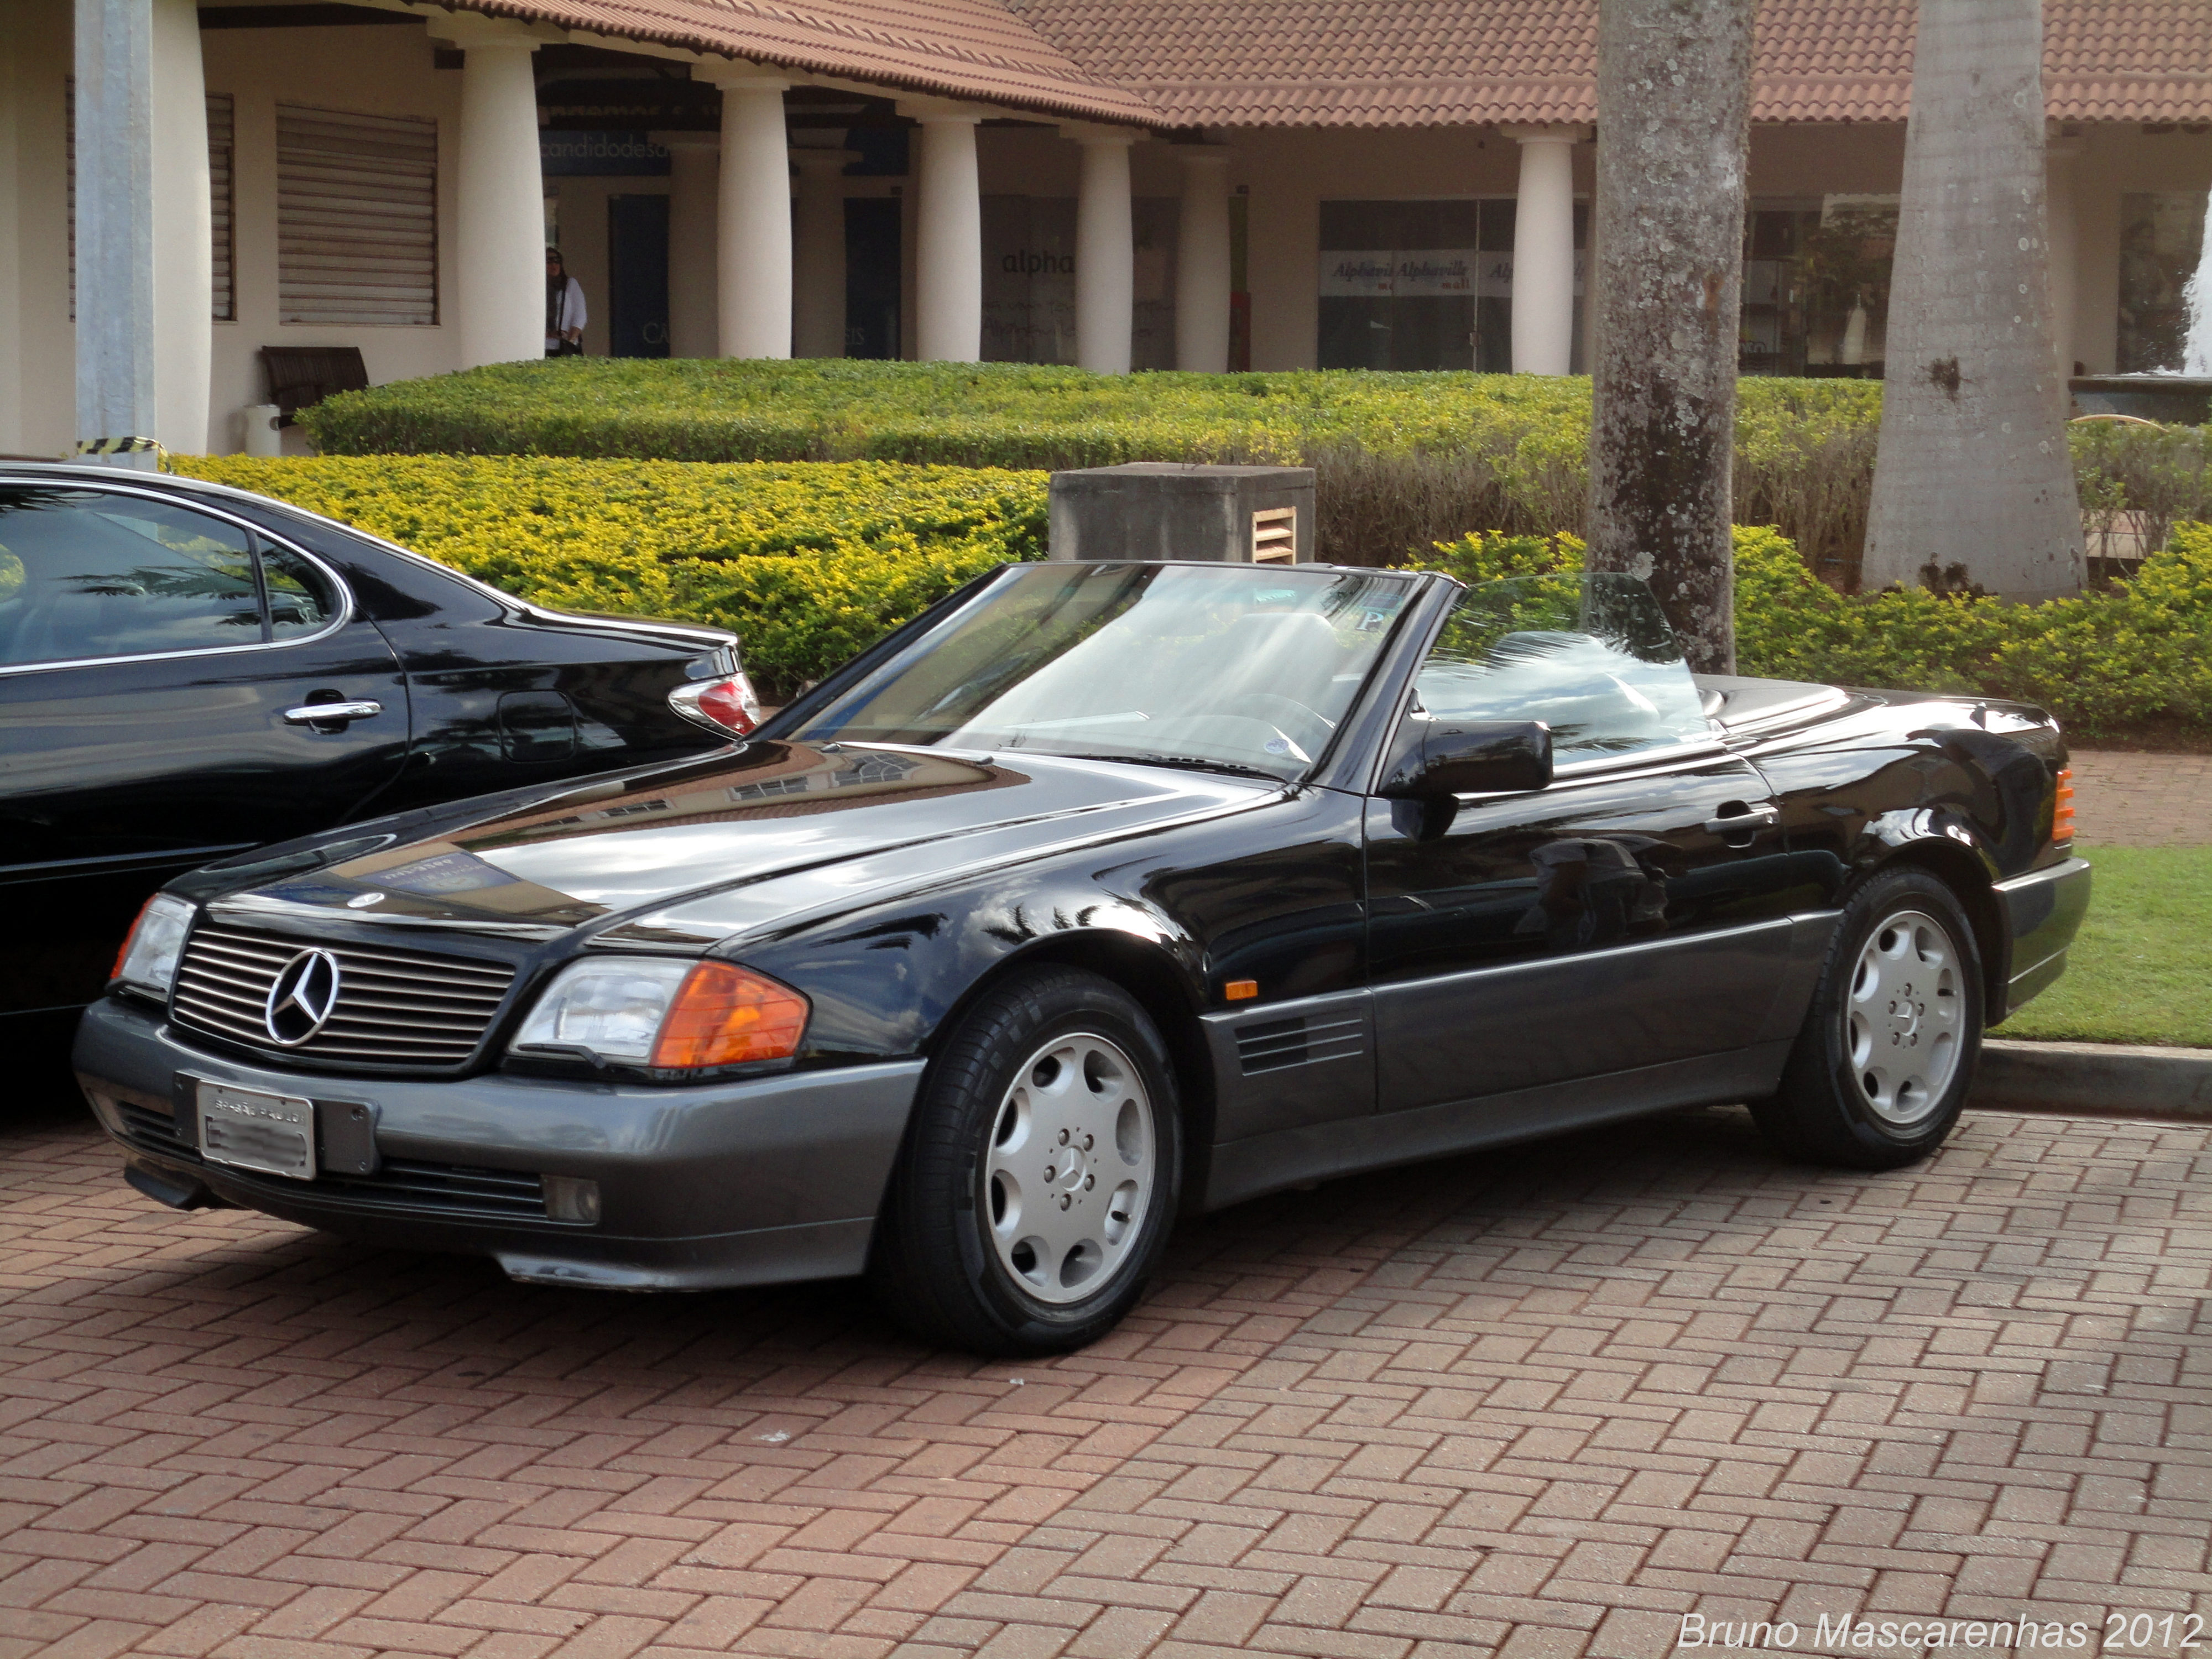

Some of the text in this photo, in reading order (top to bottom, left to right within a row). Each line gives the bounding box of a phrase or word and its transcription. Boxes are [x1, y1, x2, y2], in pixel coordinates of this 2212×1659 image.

[1002, 249, 1075, 276] alpha
[1396, 260, 1468, 281] Alphaville
[1442, 278, 1469, 289] mall
